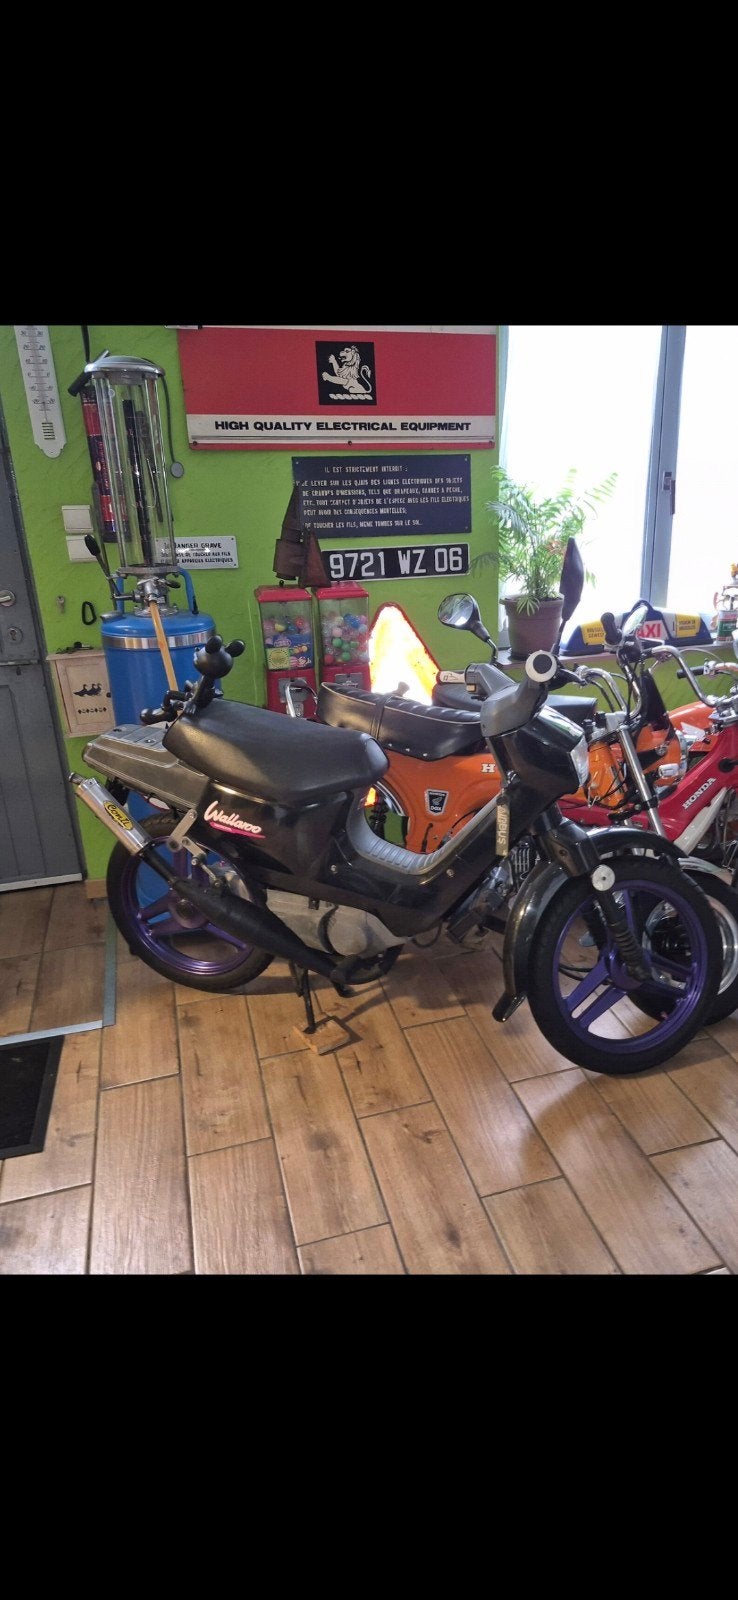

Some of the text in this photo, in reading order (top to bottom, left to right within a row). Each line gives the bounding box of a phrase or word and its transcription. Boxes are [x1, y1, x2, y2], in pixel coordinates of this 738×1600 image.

[214, 420, 472, 432] HIGH QUALITY ELECTRICAL EQUIPMENT
[329, 547, 462, 578] 9721 WZ 06
[682, 778, 716, 810] HONDA
[204, 800, 262, 833] Wallaroo
